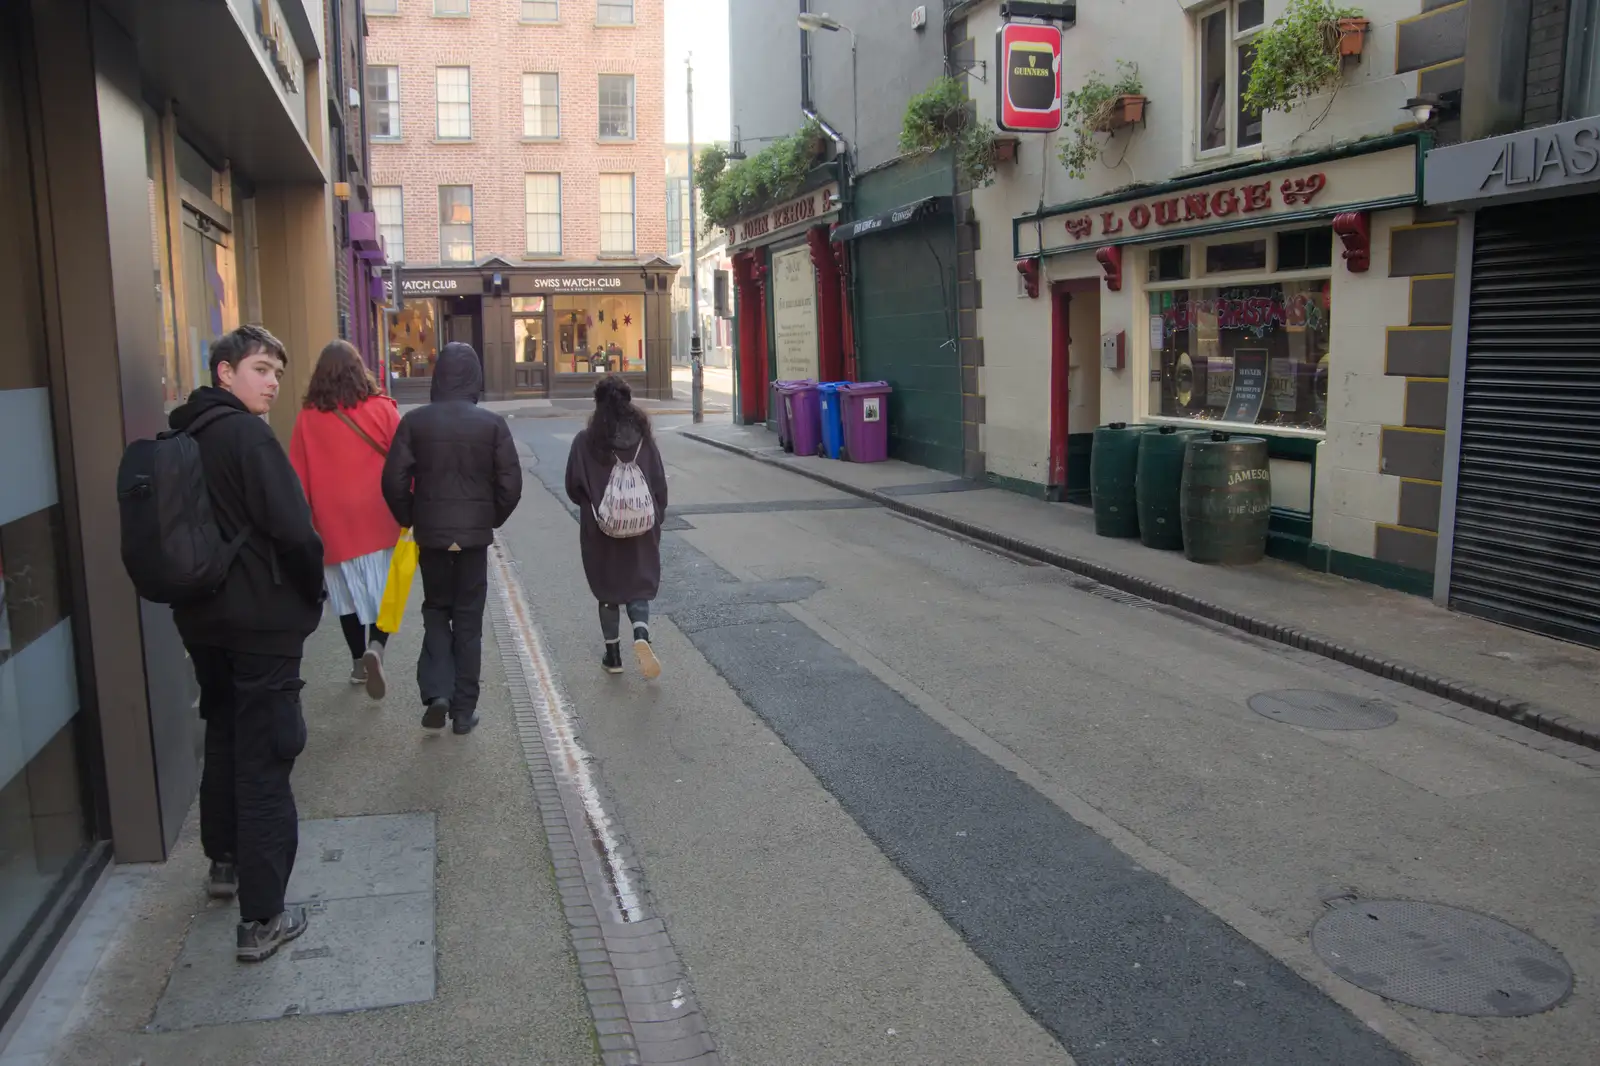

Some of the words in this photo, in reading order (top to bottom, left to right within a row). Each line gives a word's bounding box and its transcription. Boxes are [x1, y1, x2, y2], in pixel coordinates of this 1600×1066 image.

[1014, 67, 1049, 77] GUINNESS
[1479, 129, 1600, 192] ALIAS
[740, 214, 769, 241] JOHN
[773, 197, 816, 229] KEHOE
[1100, 180, 1272, 234] LOUNGE
[402, 280, 431, 290] ATCH
[432, 279, 457, 289] CLUB
[534, 278, 560, 288] SWISS
[561, 278, 596, 287] WATCH
[597, 277, 621, 287] CLUB
